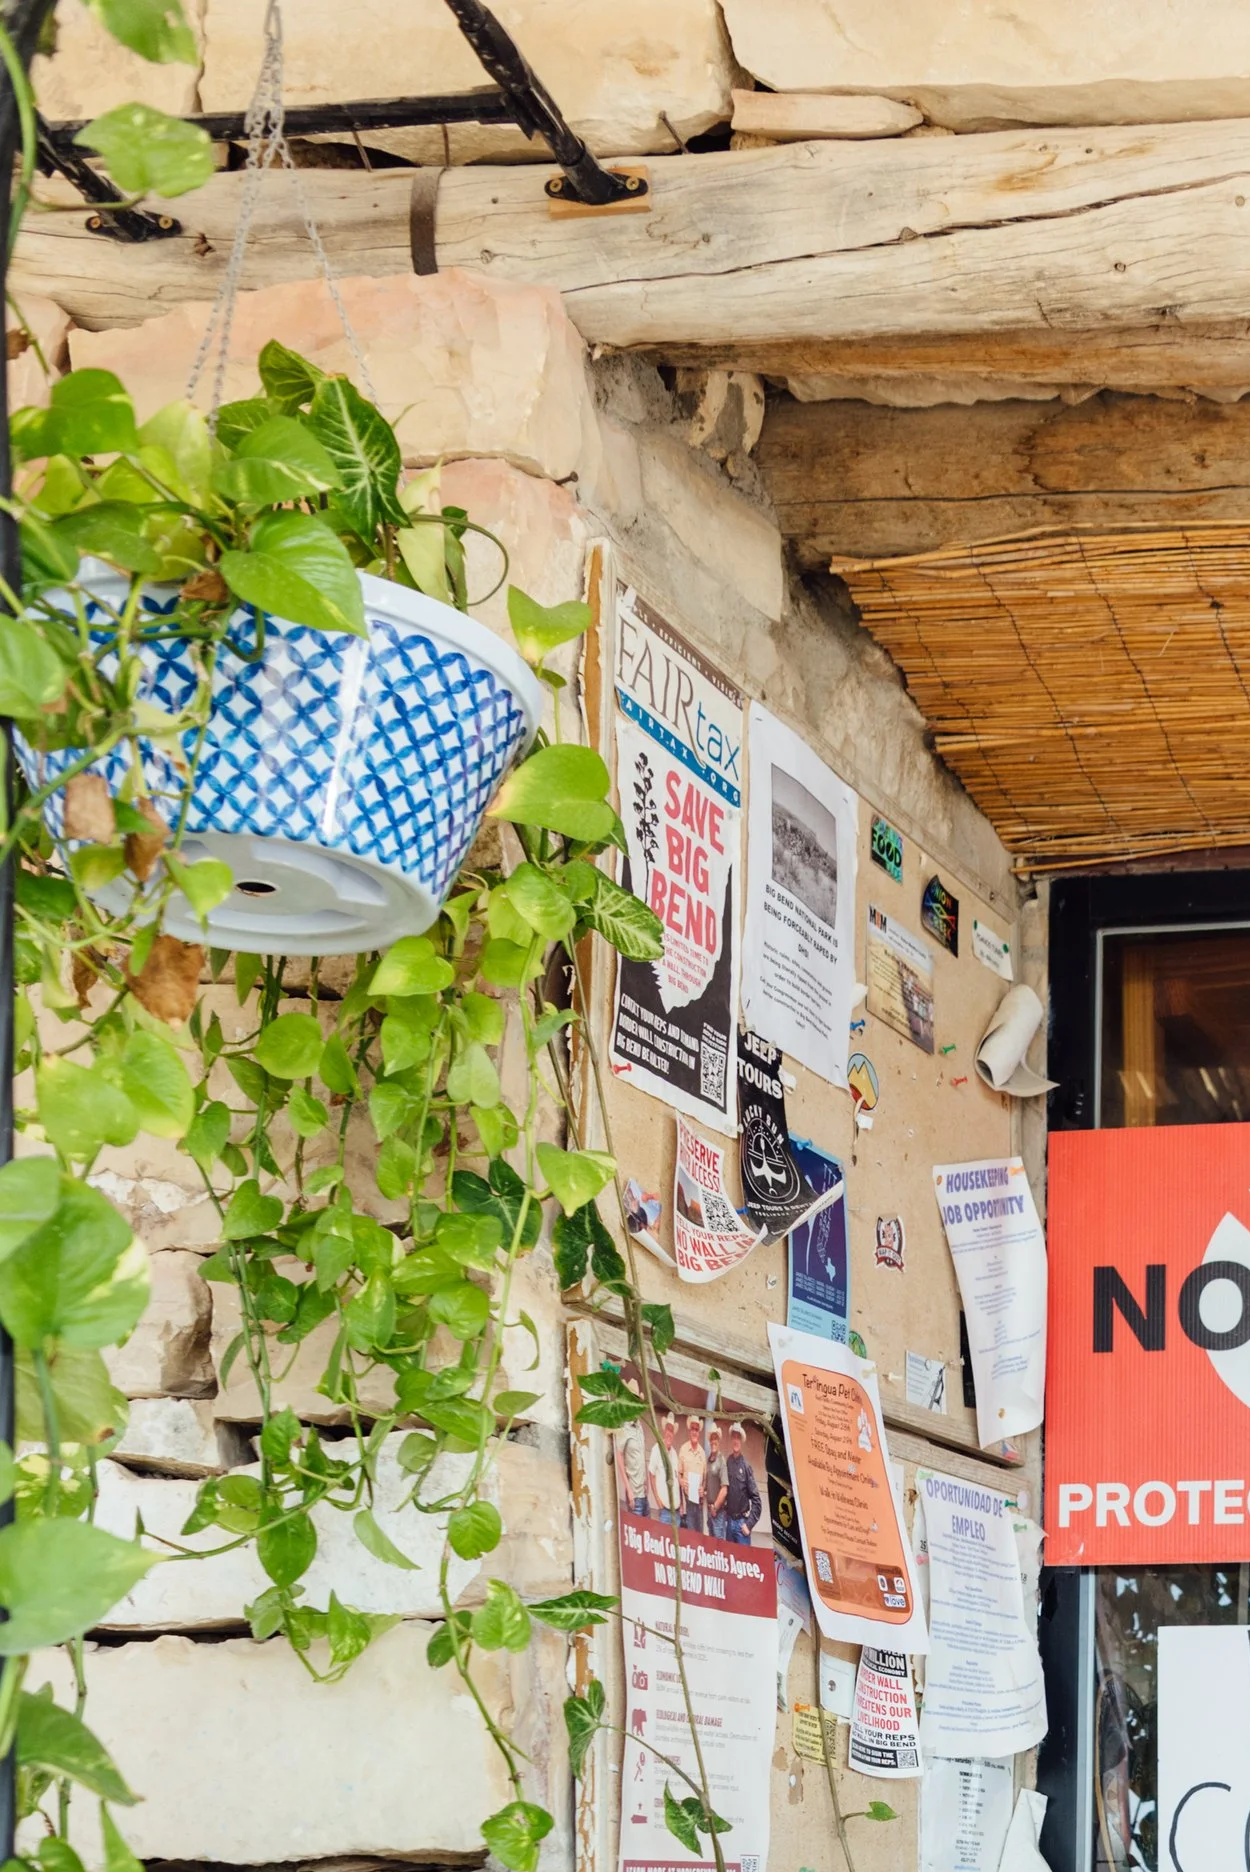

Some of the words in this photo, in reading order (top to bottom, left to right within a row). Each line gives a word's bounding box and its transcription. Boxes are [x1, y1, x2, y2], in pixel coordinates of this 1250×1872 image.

[664, 770, 724, 855] SAVE
[666, 824, 709, 896] BIG
[872, 829, 902, 868] FOOD
[650, 868, 716, 955] BEND
[763, 901, 782, 921] BEING
[765, 884, 775, 898] BIG
[777, 892, 794, 910] BEND
[795, 904, 817, 932] NATIONAL
[818, 926, 832, 943] PARK
[744, 1033, 777, 1066] JEEP
[737, 1057, 783, 1100] TOURS
[766, 1115, 785, 1146] SUN
[679, 1119, 720, 1174] PRESERVE
[692, 1159, 721, 1194] ACCESS!
[946, 1167, 1009, 1194] HOUSEKEEPING
[943, 1204, 963, 1226] JOB
[964, 1194, 1024, 1223] OPPORTUNITY
[676, 1227, 688, 1251] NO
[689, 1235, 733, 1258] WALL
[692, 1226, 715, 1241] YOUR
[677, 1250, 703, 1272] BIG
[838, 1383, 850, 1399] Pet
[926, 1478, 992, 1514] OPORTUNIDAD
[992, 1499, 1003, 1518] DE
[951, 1515, 986, 1541] EMPLEO
[629, 1527, 643, 1555] Big
[644, 1530, 665, 1557] Bend
[730, 1552, 764, 1582] Agree,
[654, 1561, 665, 1585] NO
[704, 1574, 726, 1599] WALL
[877, 1676, 903, 1691] WALL
[857, 1711, 900, 1732] LIVELIHOOD
[889, 1706, 912, 1718] OUR
[864, 1729, 883, 1739] YOUR
[885, 1733, 915, 1741] REPS
[875, 1739, 888, 1747] BIG
